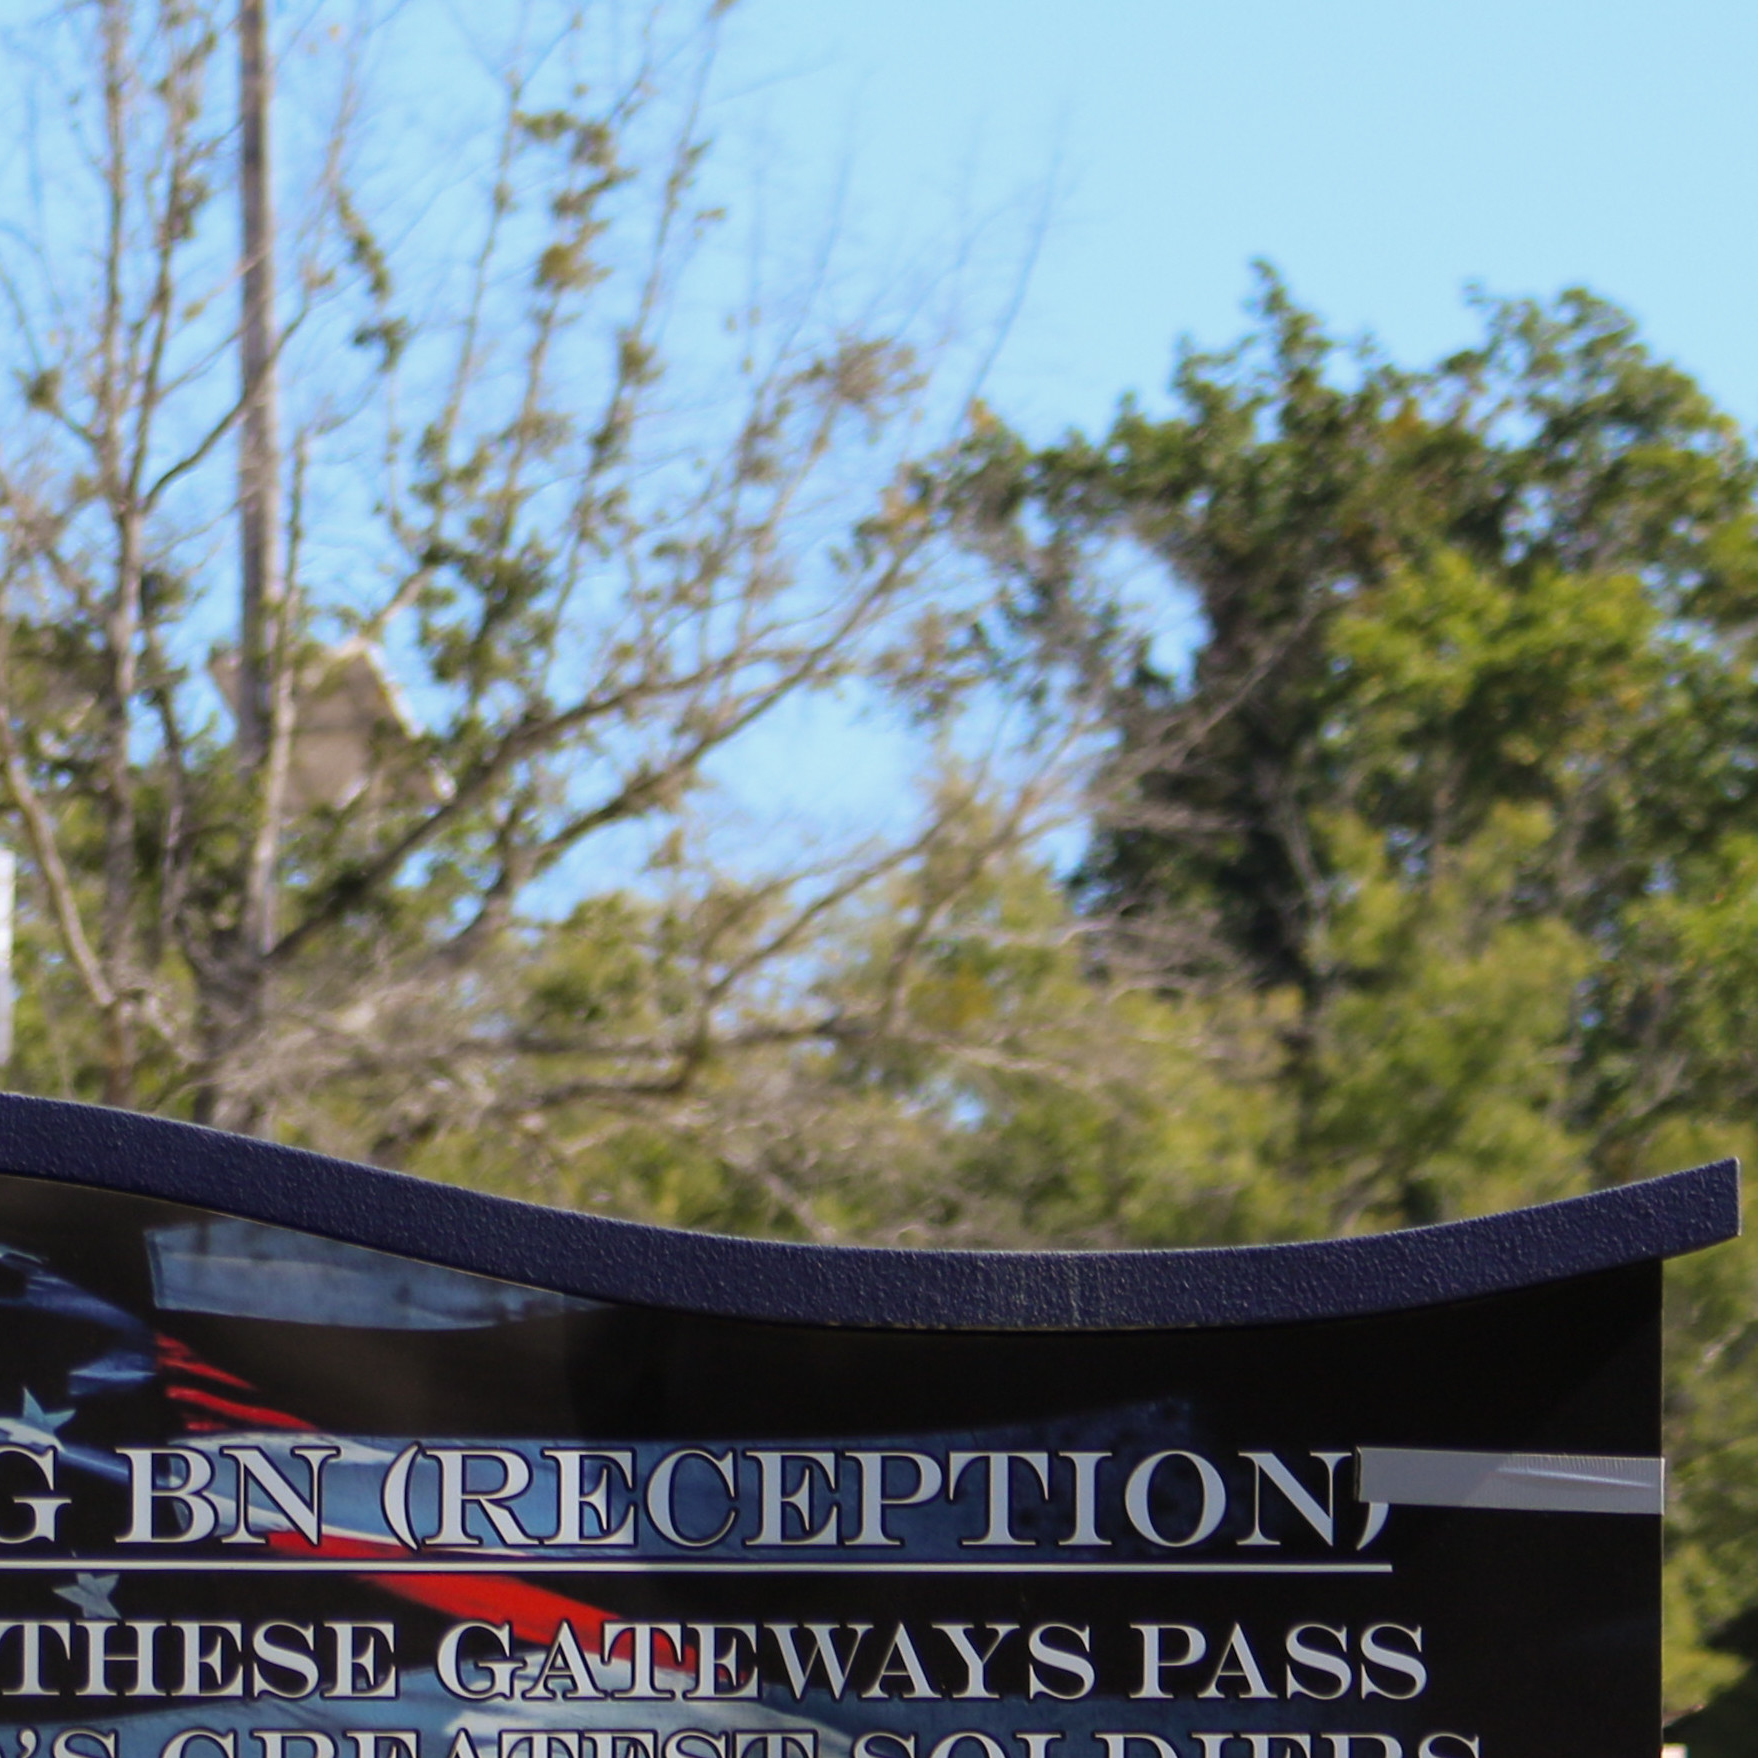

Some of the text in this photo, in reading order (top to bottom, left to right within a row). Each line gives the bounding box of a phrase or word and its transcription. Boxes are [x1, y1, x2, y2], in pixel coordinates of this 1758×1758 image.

[116, 1446, 342, 1546] BN
[434, 1621, 1097, 1701] GATEWAYS
[1128, 1623, 1428, 1700] PASS
